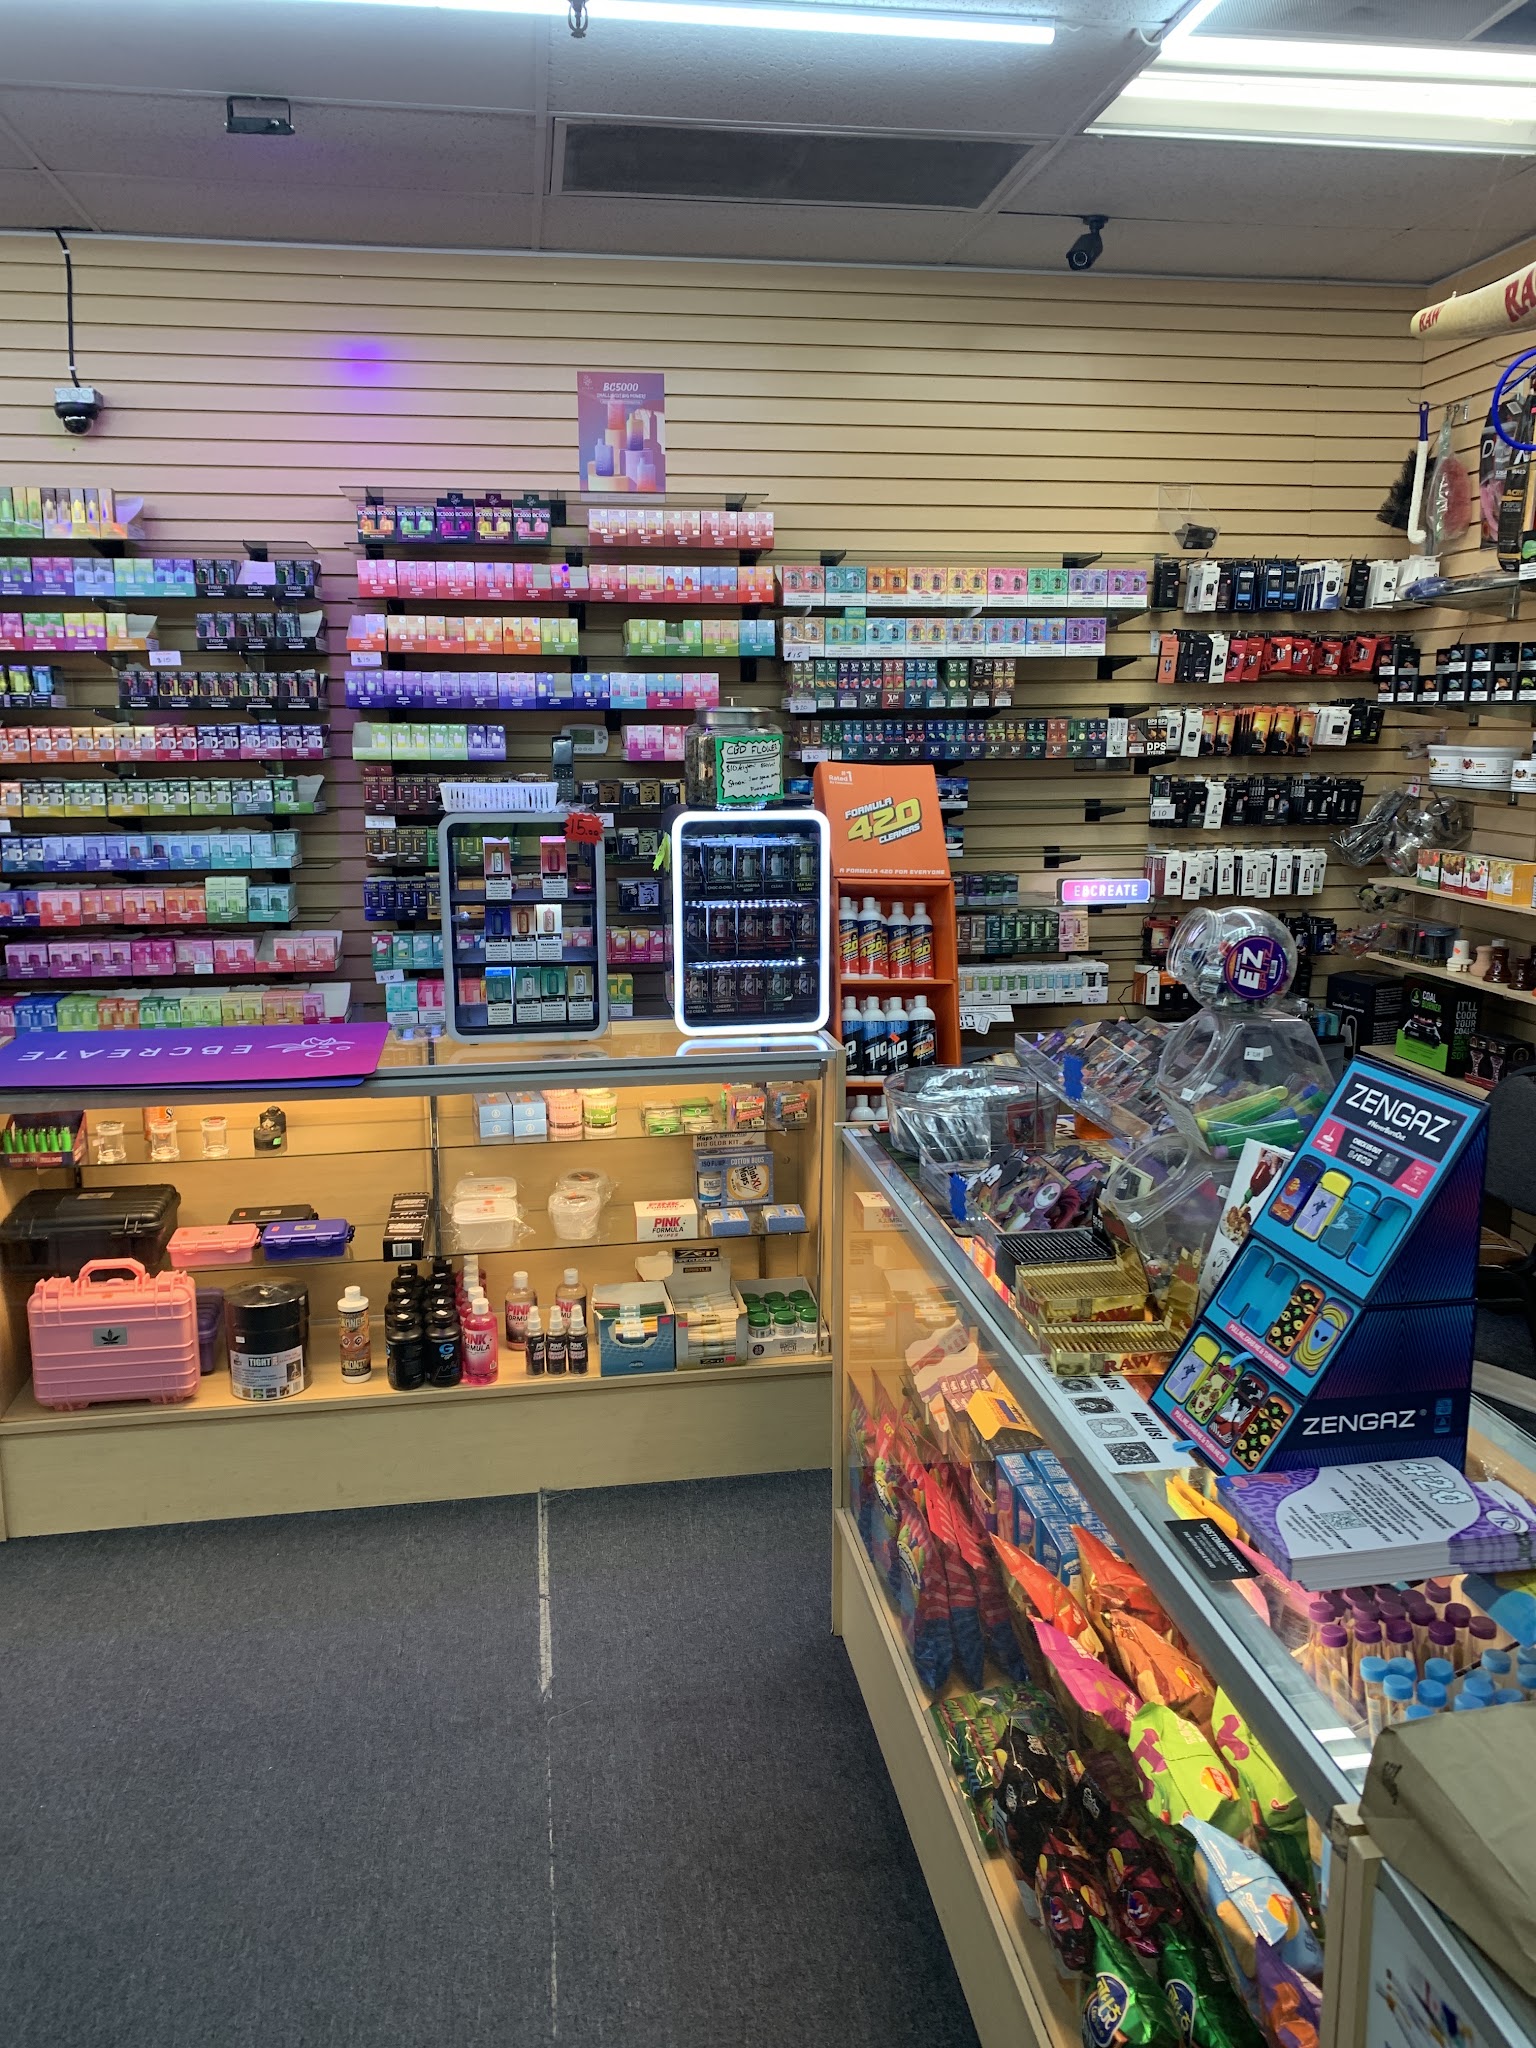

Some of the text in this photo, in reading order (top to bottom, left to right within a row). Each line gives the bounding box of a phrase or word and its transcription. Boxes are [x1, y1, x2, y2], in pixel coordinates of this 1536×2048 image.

[1504, 268, 1536, 323] RA
[1419, 304, 1446, 333] RAW
[603, 382, 639, 392] BC5000
[726, 745, 747, 755] CBD
[1146, 742, 1167, 751] DPS
[844, 796, 893, 820] FORMULA
[847, 798, 922, 842] 420
[878, 823, 922, 844] CLEANERS
[1073, 884, 1139, 898] EBCREATE
[859, 939, 883, 958] 420
[890, 946, 911, 963] 420
[1421, 990, 1437, 1003] COAL
[1456, 1001, 1479, 1012] IT'LL
[1455, 1011, 1478, 1020] COOK
[1455, 1019, 1477, 1028] YOUR
[17, 1044, 254, 1062] EBCREATE
[865, 1040, 887, 1061] 710
[1345, 1082, 1452, 1143] ZENGAZ
[730, 1156, 765, 1166] COTTON BUDS
[652, 1226, 684, 1234] FORMULA
[653, 1217, 681, 1228] PINK
[249, 1358, 272, 1367] TIGHT
[1103, 1354, 1153, 1374] RAW
[1102, 1377, 1126, 1391] Us!
[1130, 1411, 1169, 1440] Add Us!
[1302, 1409, 1416, 1436] ZENGAZ
[1397, 1461, 1473, 1504] 420
[1198, 1522, 1231, 1552] CUSTOMER
[1223, 1552, 1249, 1573] NOTICE
